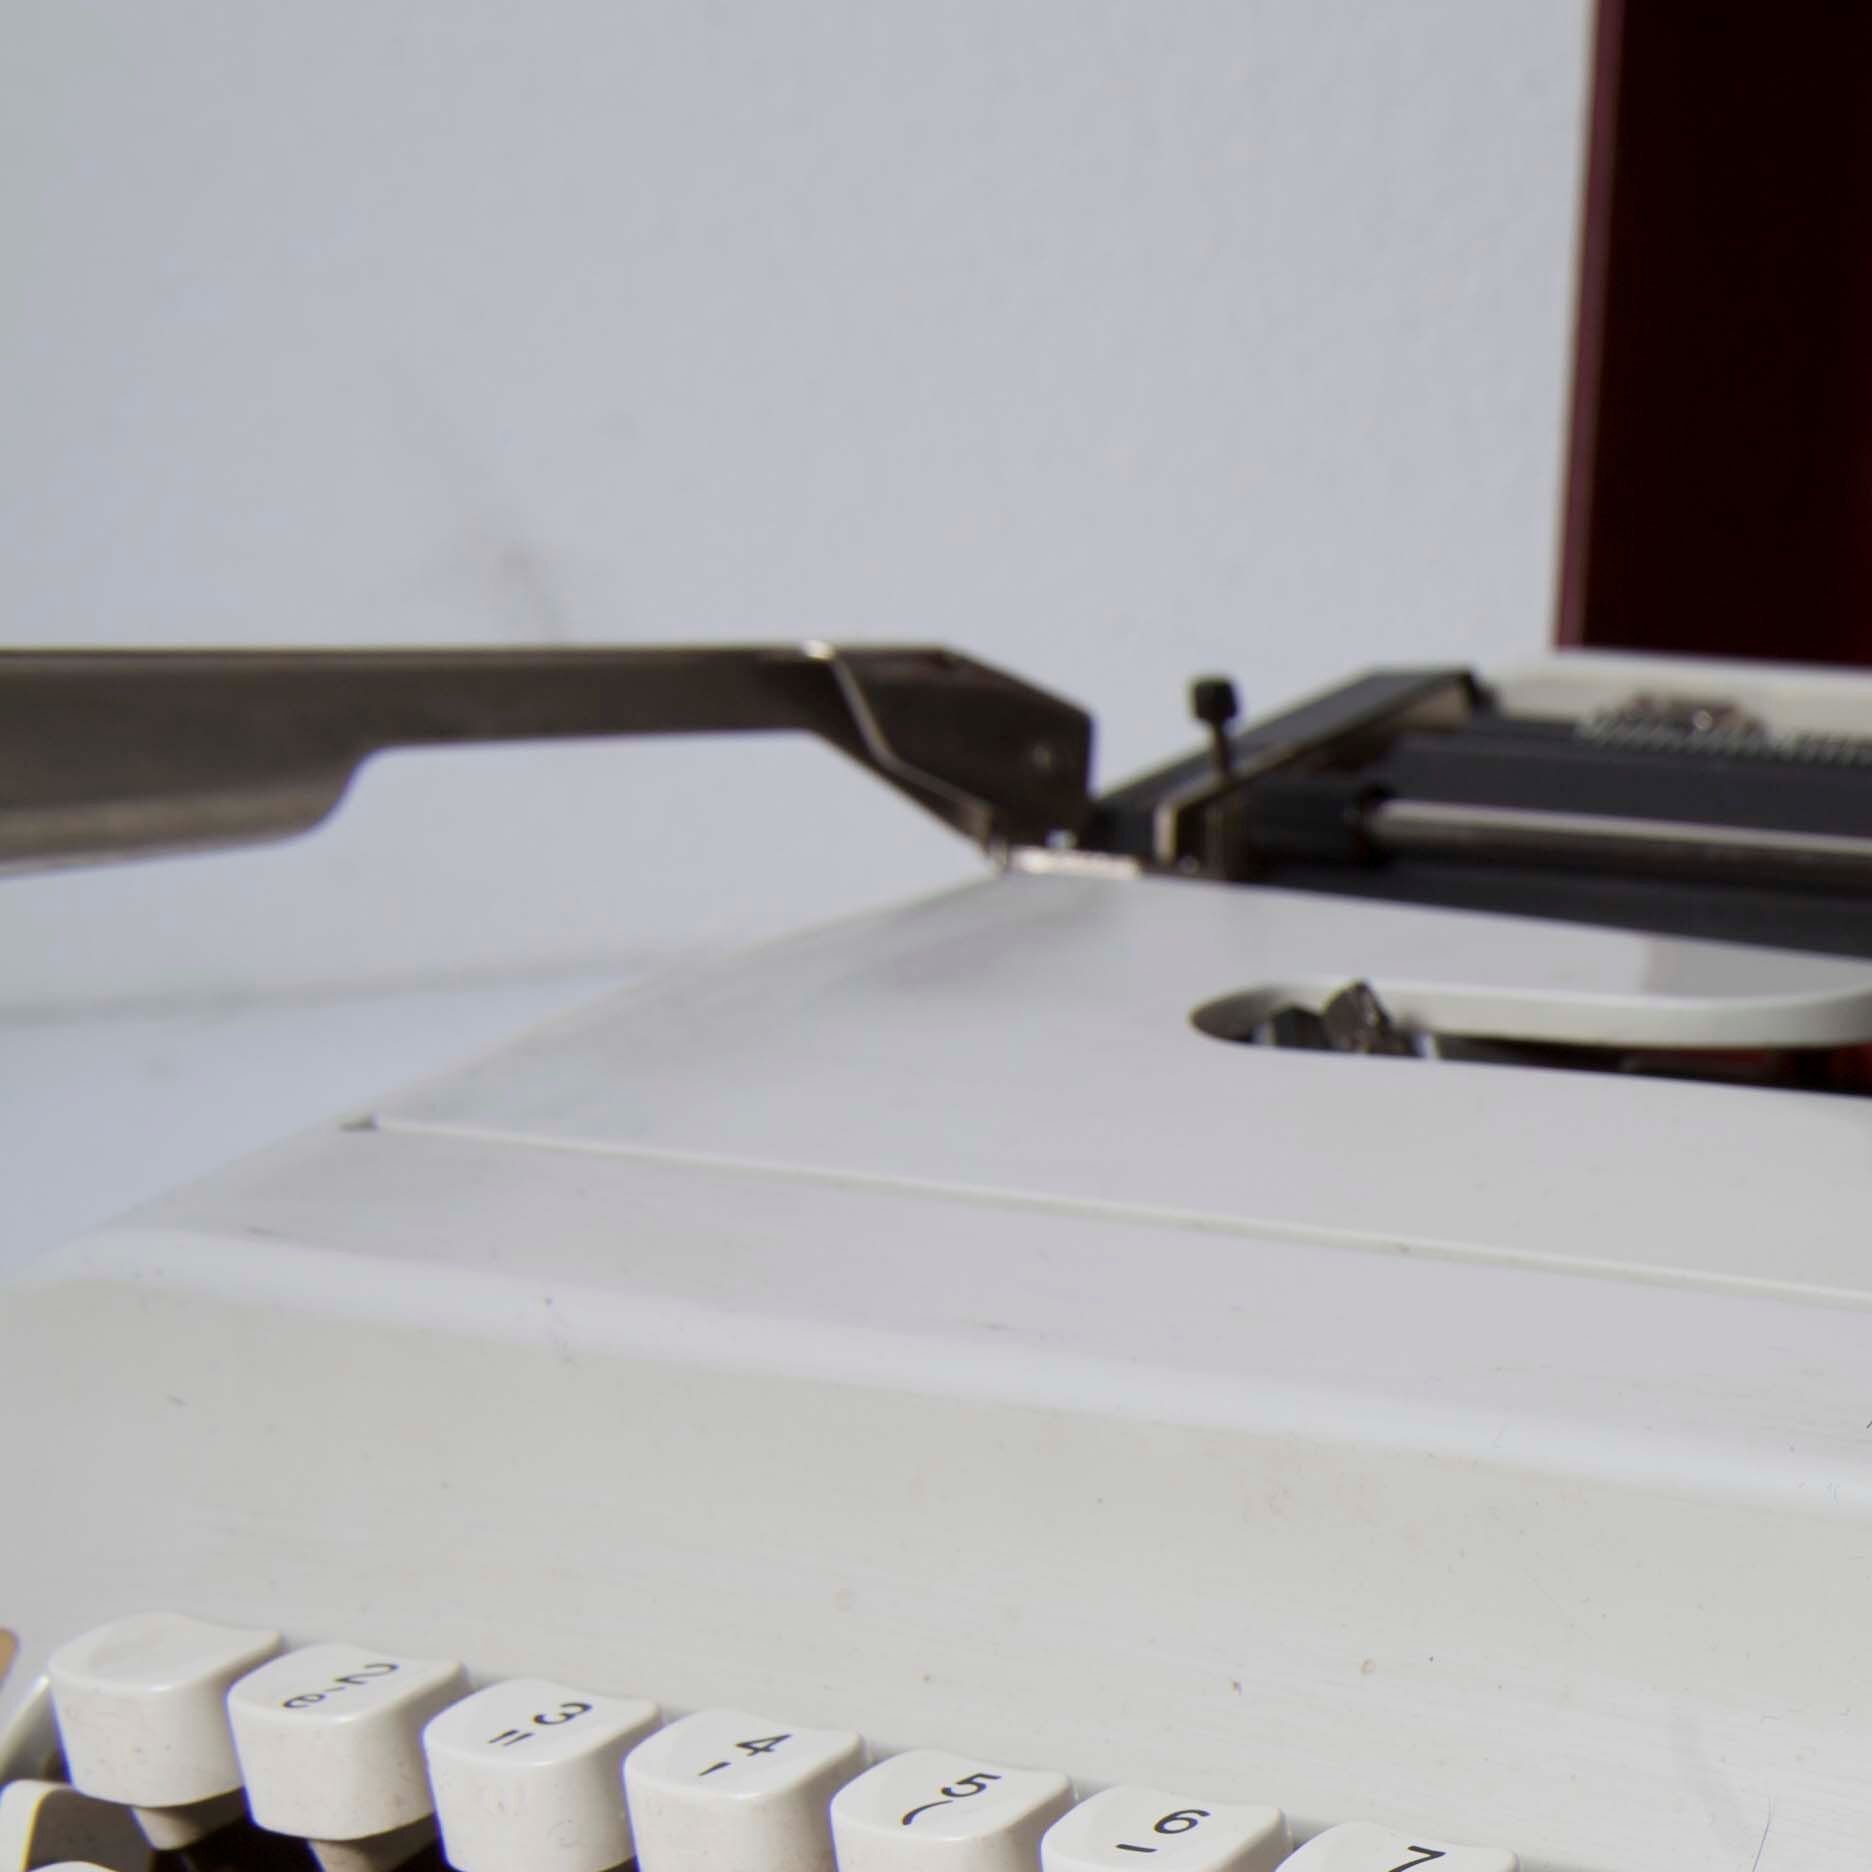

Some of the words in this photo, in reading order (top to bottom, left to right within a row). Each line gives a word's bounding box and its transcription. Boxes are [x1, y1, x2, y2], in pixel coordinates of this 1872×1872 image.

[339, 1662, 400, 1686] 2
[532, 1701, 593, 1726] 3
[735, 1733, 791, 1757] 4
[940, 1772, 1002, 1799] 5
[1152, 1808, 1211, 1836] 6
